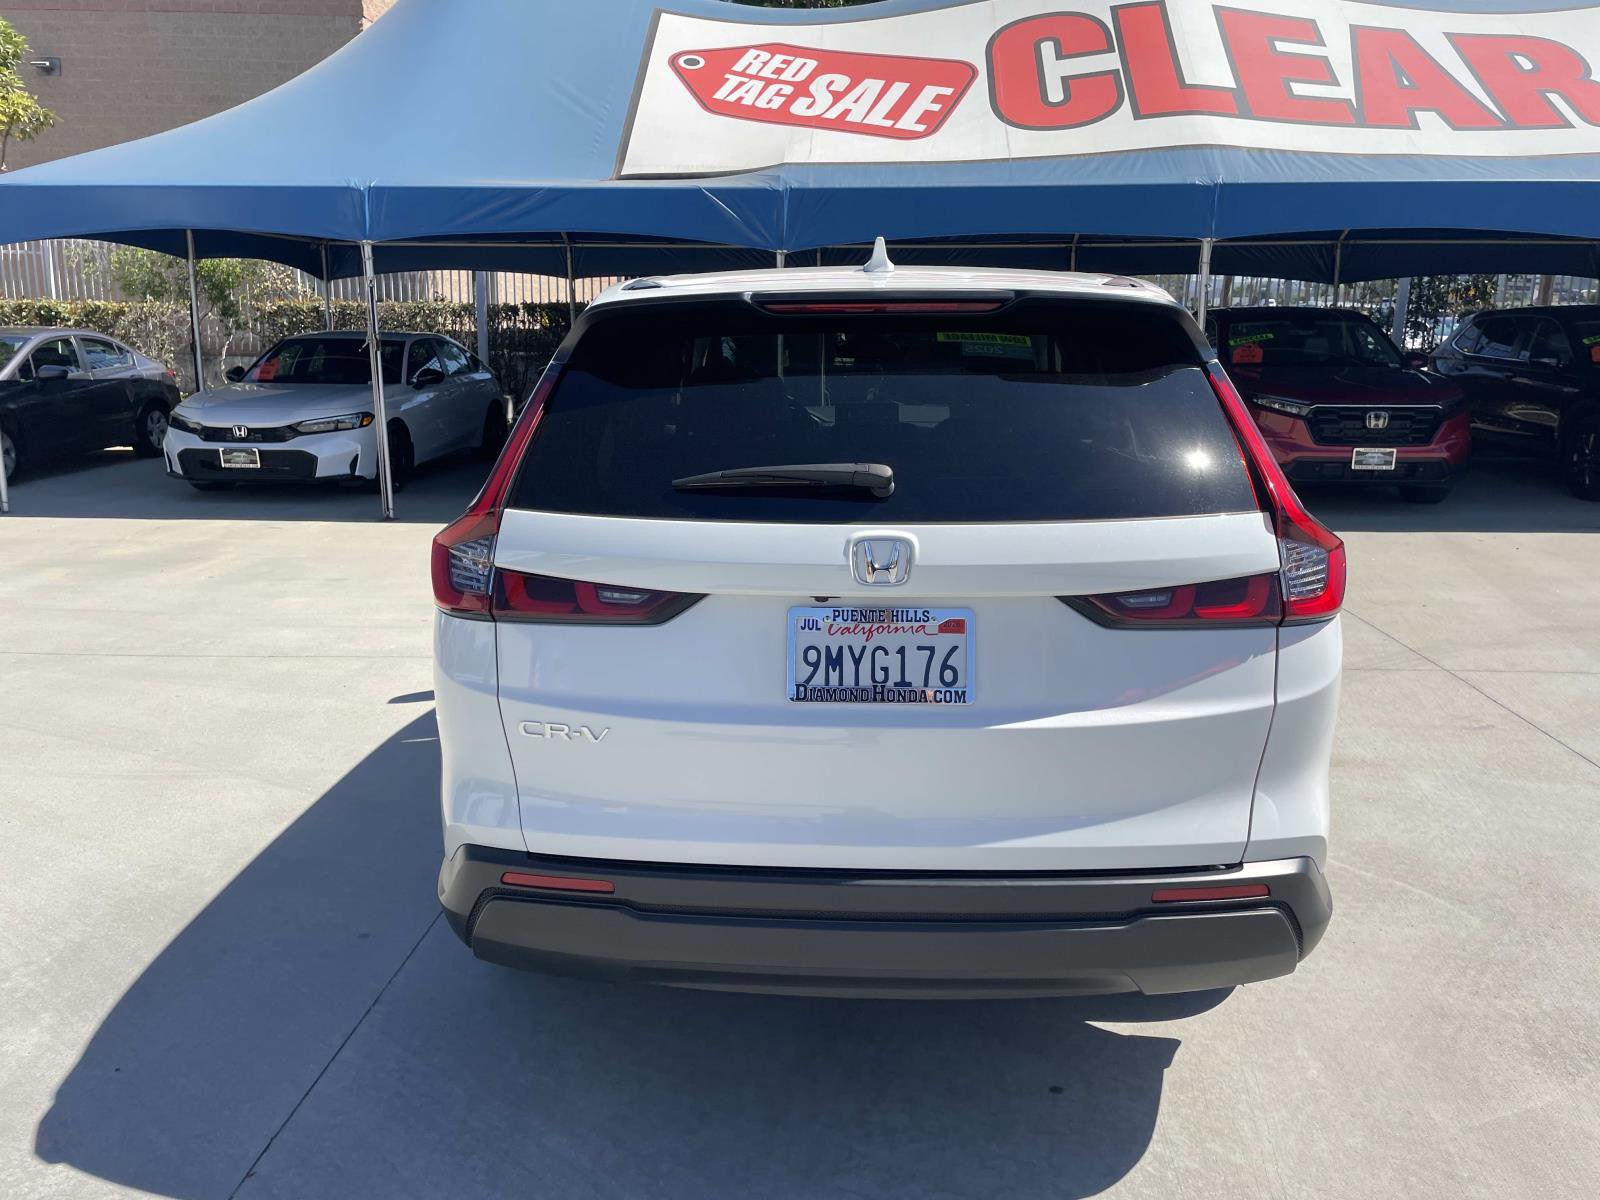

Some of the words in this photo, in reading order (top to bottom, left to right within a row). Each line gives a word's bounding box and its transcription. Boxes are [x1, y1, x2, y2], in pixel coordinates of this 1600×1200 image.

[731, 48, 818, 82] RED
[985, 0, 1600, 131] CLEAR
[712, 74, 794, 109] TAG
[789, 73, 954, 132] SALE
[800, 618, 821, 631] JUL
[832, 609, 886, 623] PUENTE
[892, 609, 930, 623] HILLS
[828, 623, 938, 642] California
[802, 645, 960, 687] 9MYG176
[519, 720, 610, 743] CR-V
